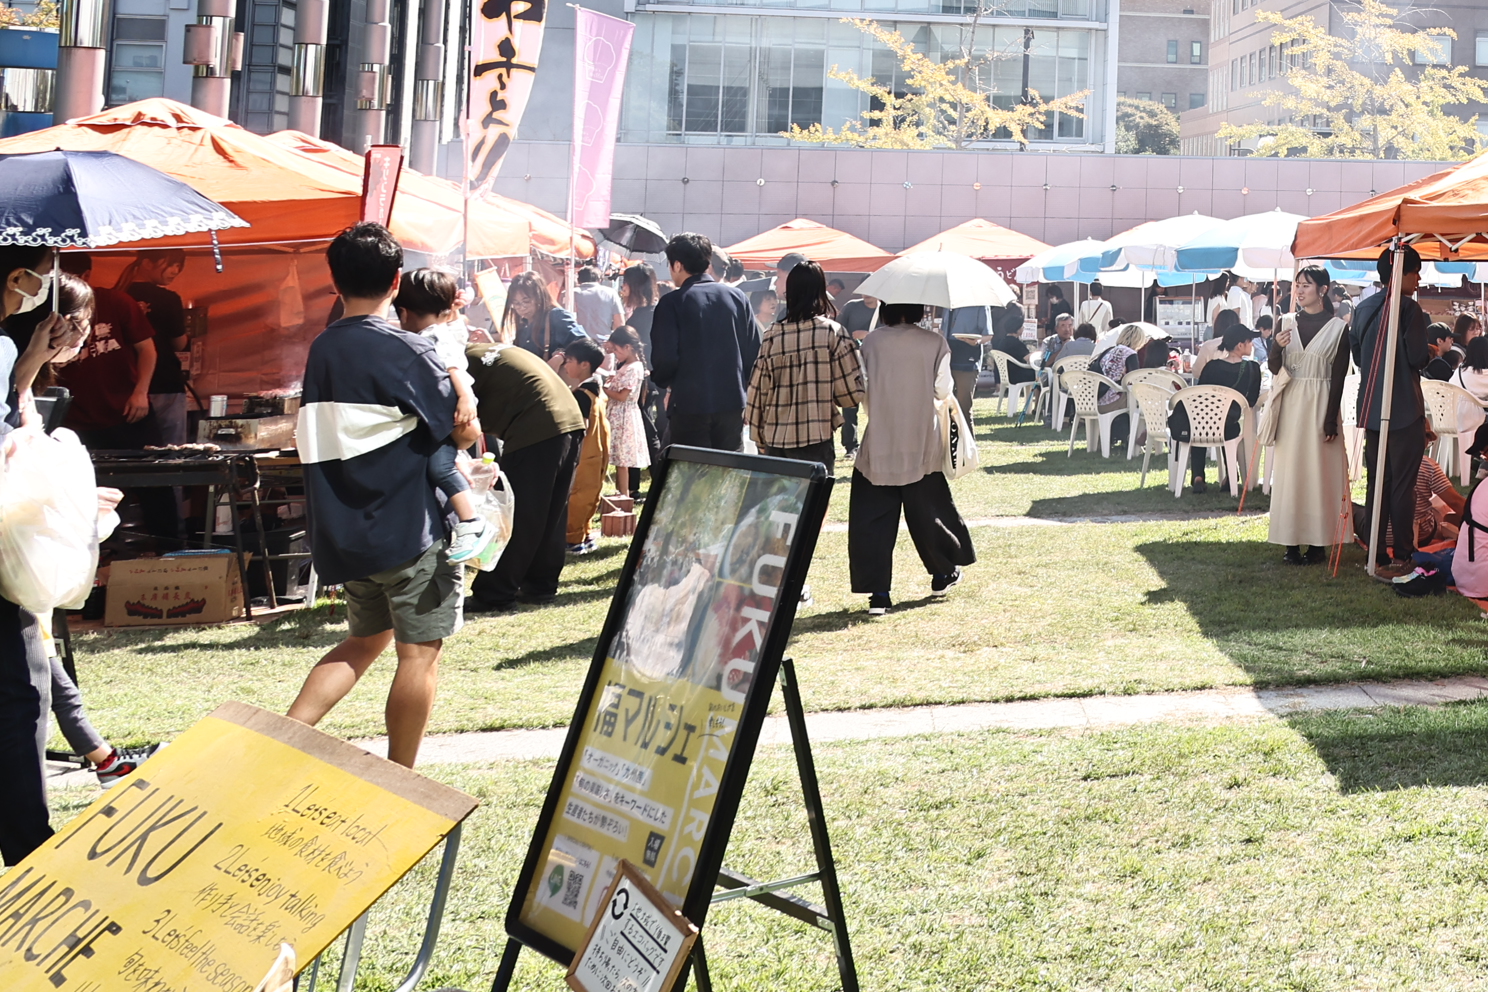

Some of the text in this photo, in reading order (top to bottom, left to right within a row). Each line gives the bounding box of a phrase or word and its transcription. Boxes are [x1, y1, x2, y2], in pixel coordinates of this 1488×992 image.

[720, 510, 800, 705] FUKU
[593, 680, 697, 765] 福マルシェ
[55, 779, 224, 887] FUKU
[319, 810, 348, 832] eat
[340, 814, 389, 846] local
[0, 866, 122, 988] MARCHE
[249, 871, 290, 905] enjoy
[278, 892, 327, 934] talking
